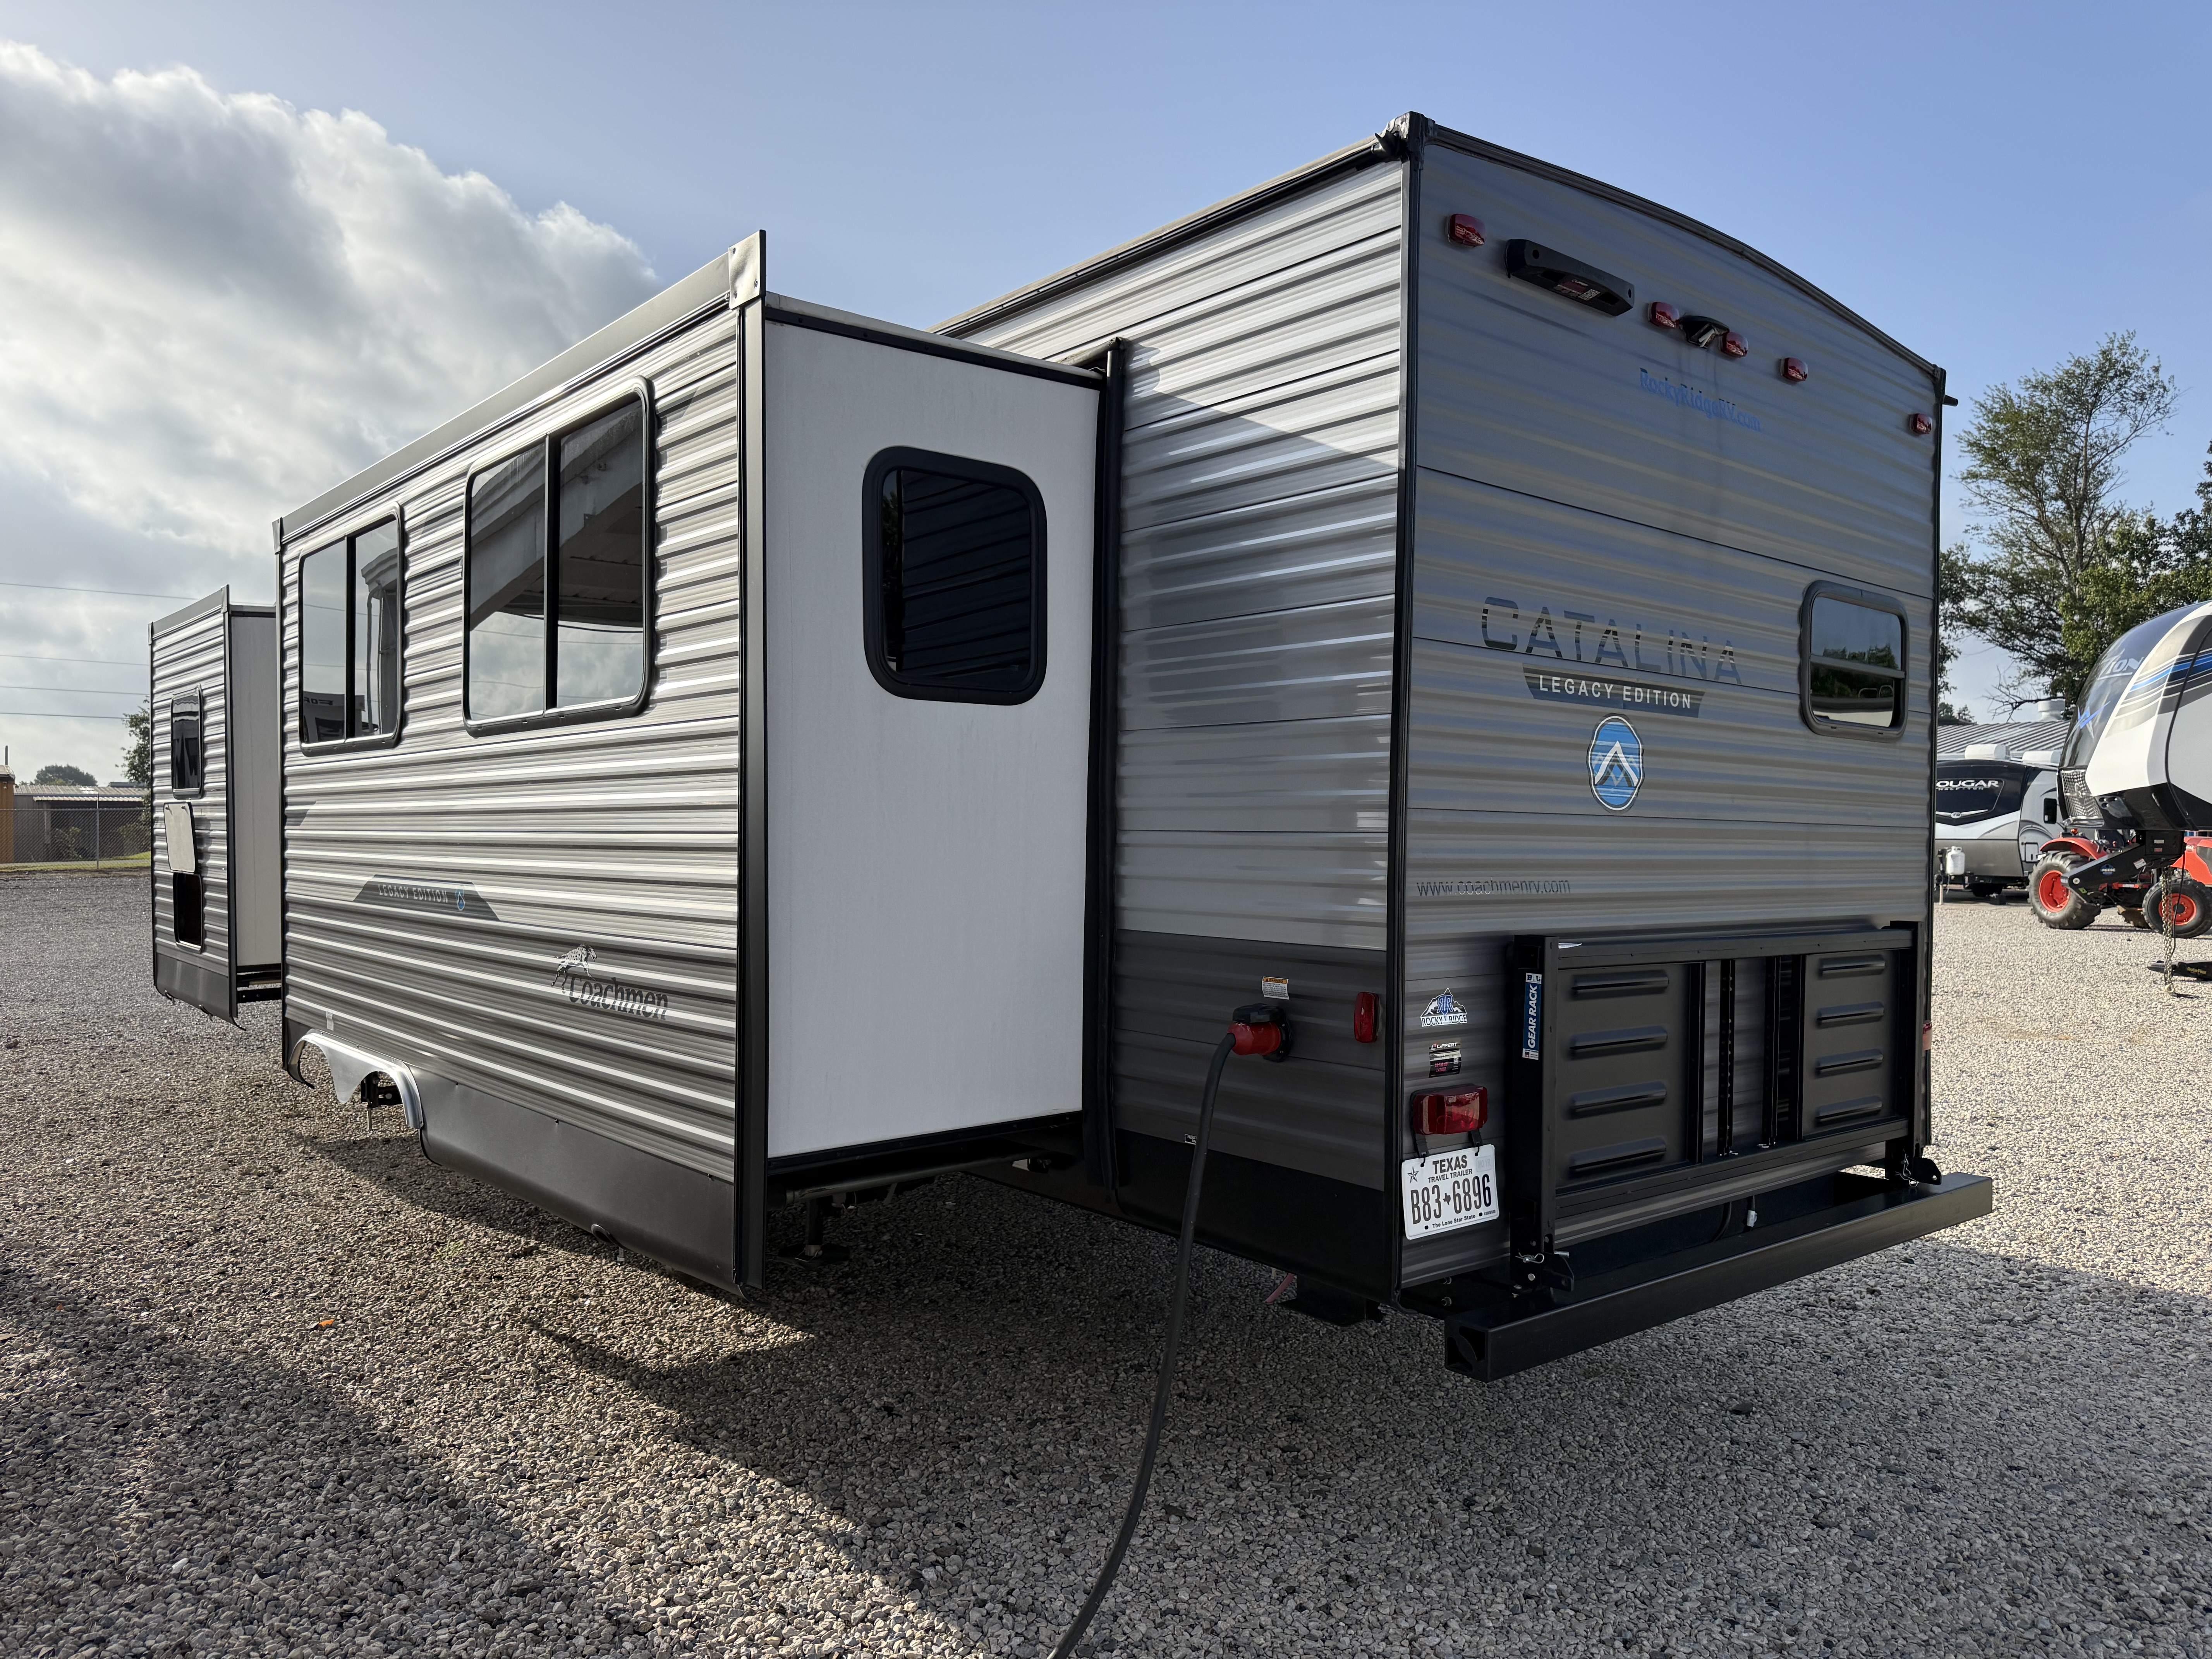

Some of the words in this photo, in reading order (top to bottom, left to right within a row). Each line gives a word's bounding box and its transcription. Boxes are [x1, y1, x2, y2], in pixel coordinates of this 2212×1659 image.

[1481, 596, 1742, 684] CATALINA
[1539, 675, 1614, 699] LEGACY
[1623, 686, 1691, 709] EDITION
[378, 884, 409, 899] LEGACY
[412, 887, 448, 903] EDITION
[1416, 876, 1571, 896] www.coachmenrv.com
[569, 974, 668, 1020] Coachmen
[1528, 984, 1537, 1017] RACK
[1422, 1016, 1443, 1026] ROCKY
[1449, 1014, 1467, 1024] RIDGE
[1528, 1017, 1536, 1048] GEAR
[1428, 1174, 1449, 1183] TRAVEL
[1450, 1168, 1472, 1179] TRAILER
[1432, 1154, 1468, 1175] TEXAS
